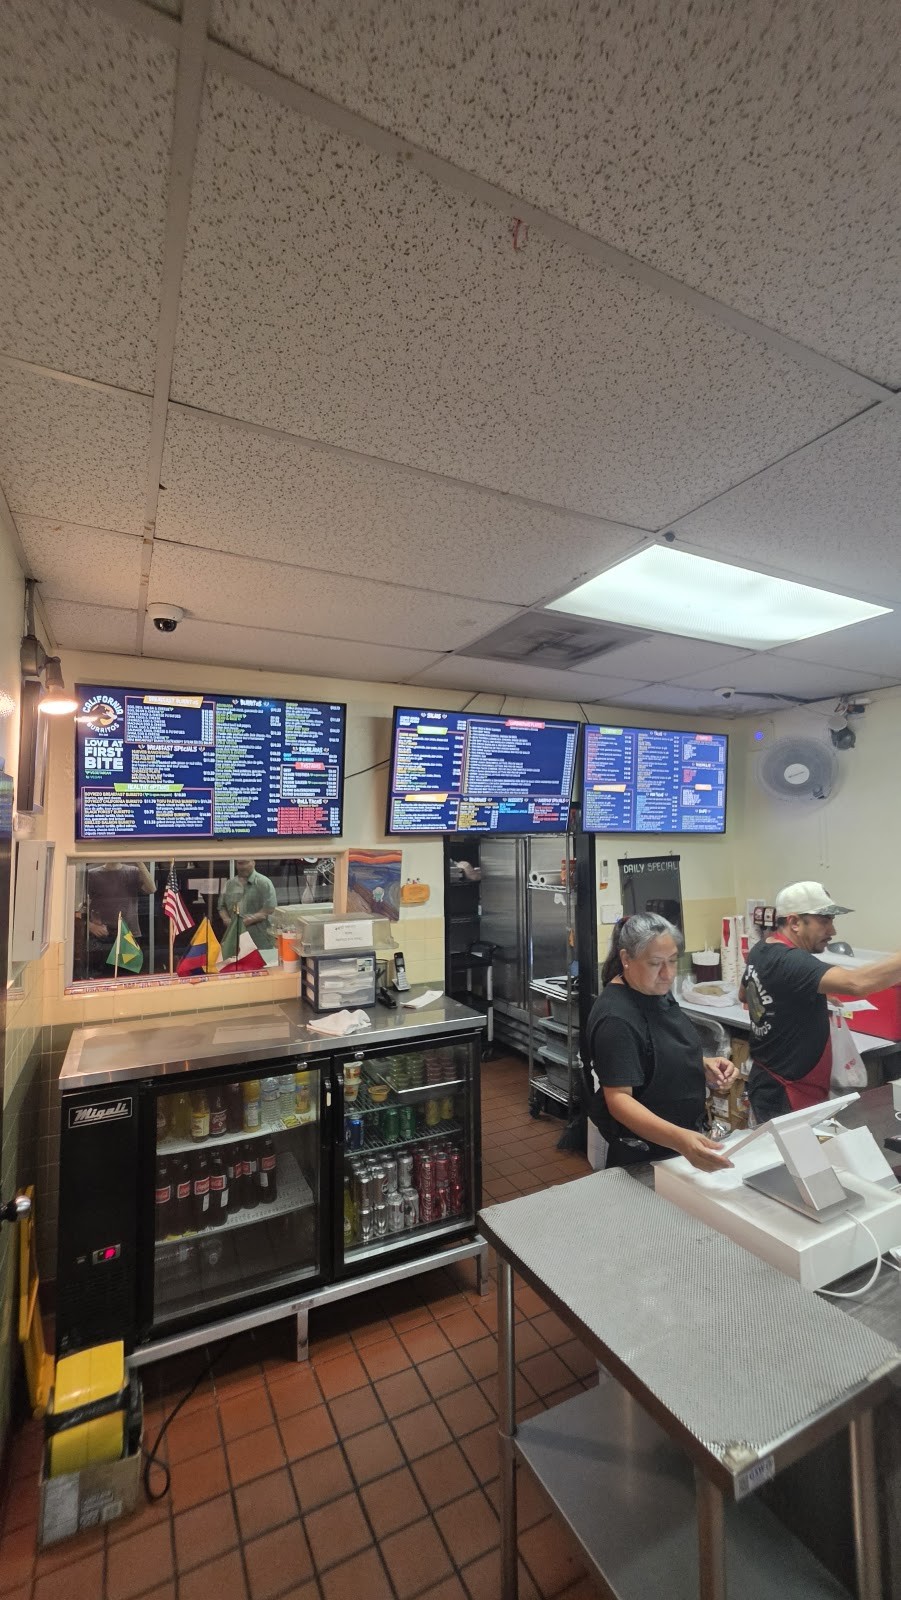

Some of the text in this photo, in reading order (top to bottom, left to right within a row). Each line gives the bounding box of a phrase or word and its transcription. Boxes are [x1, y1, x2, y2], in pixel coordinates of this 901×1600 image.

[83, 695, 124, 715] CALIFORNIA
[86, 721, 120, 734] BURRITOS
[85, 739, 123, 748] LOVE AT
[85, 747, 123, 758] FIRST
[85, 757, 123, 770] BITE
[623, 863, 645, 874] DAILY
